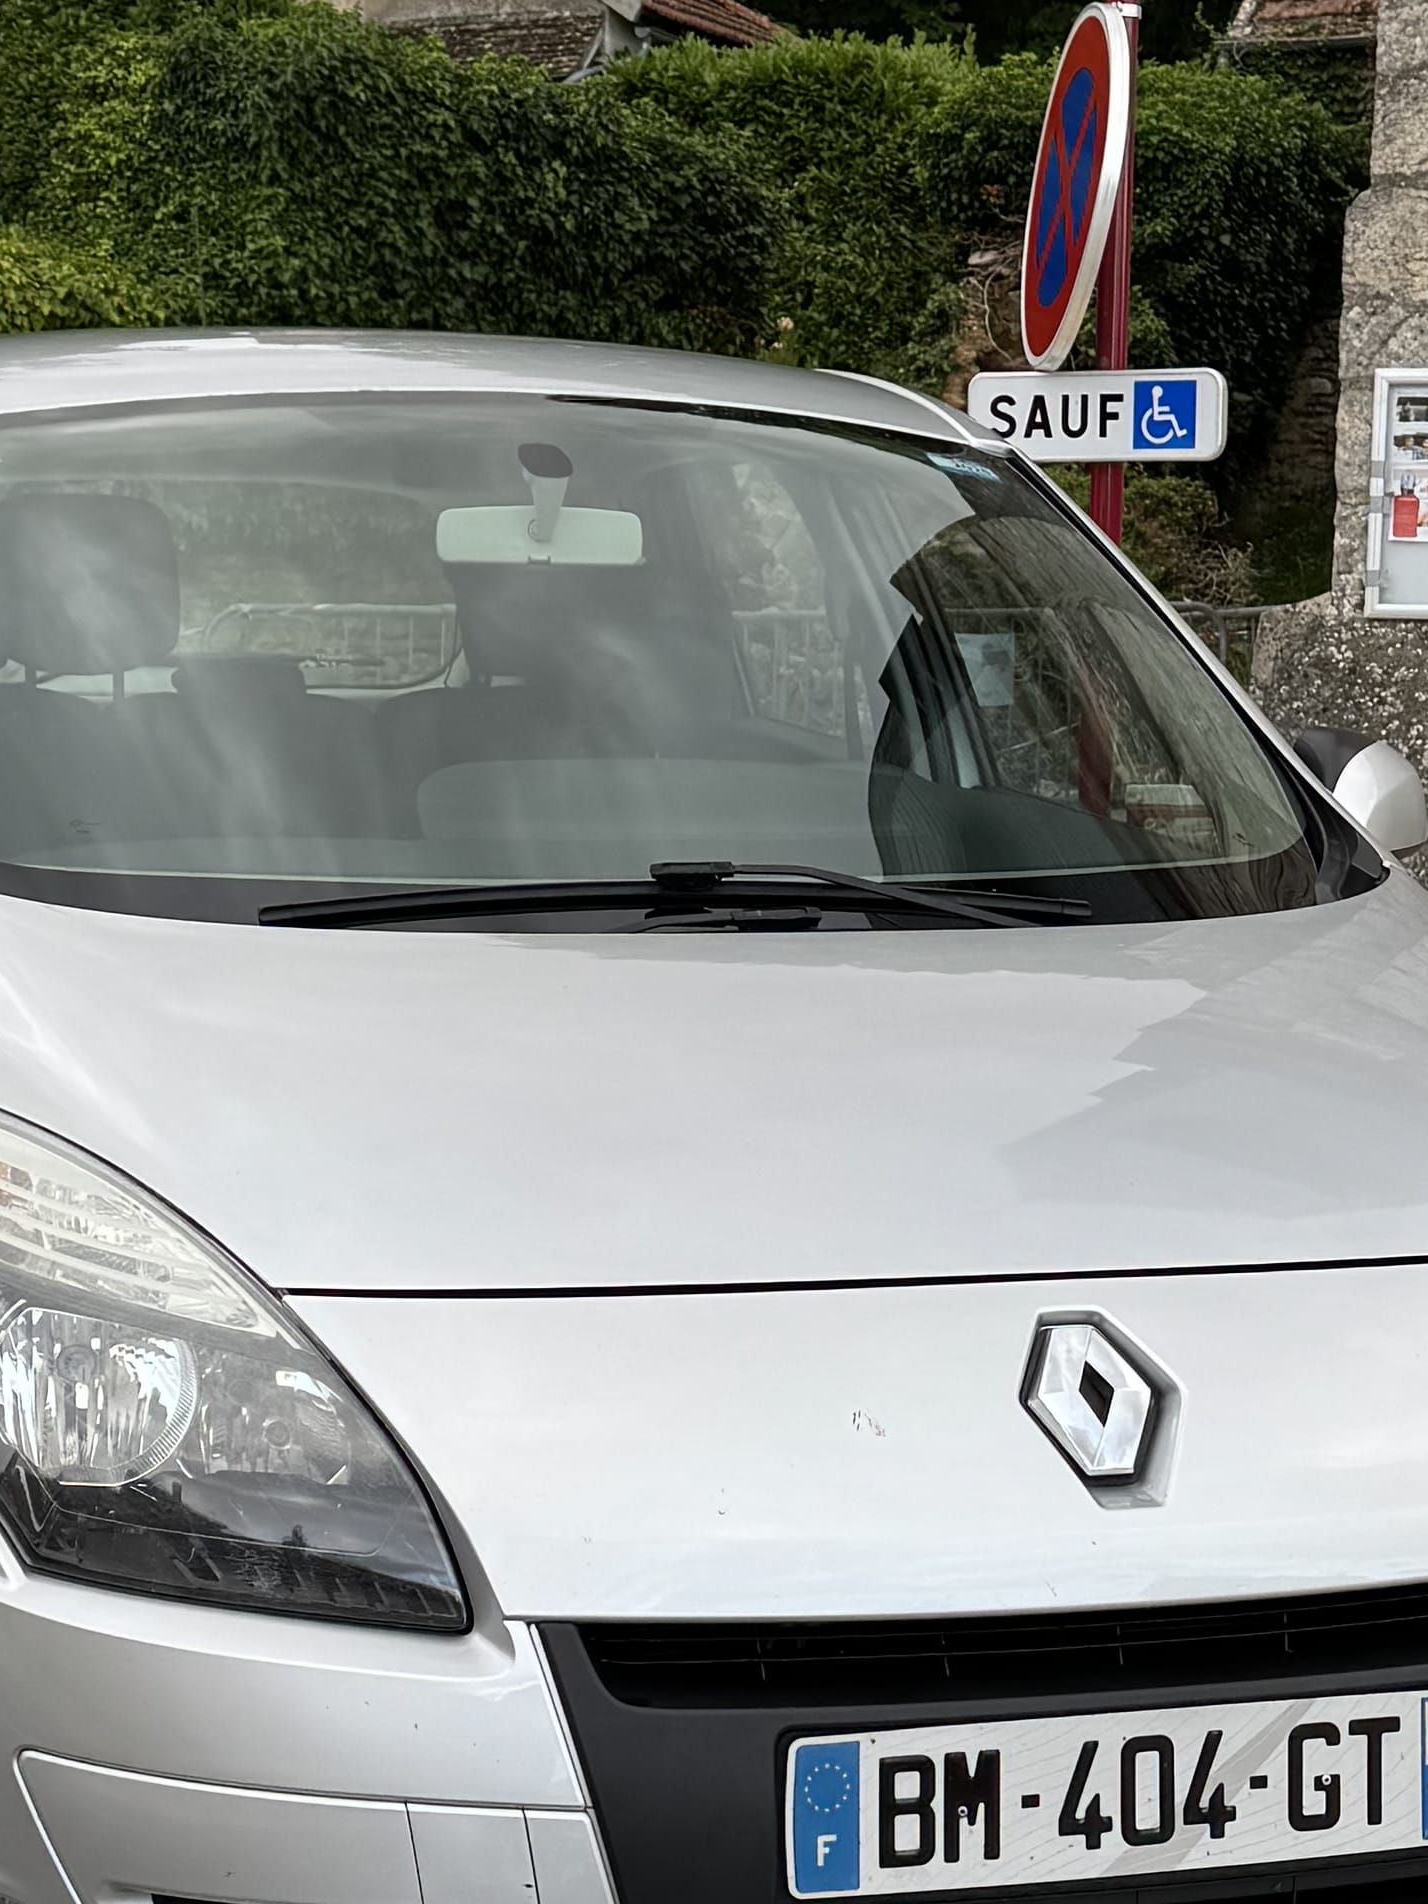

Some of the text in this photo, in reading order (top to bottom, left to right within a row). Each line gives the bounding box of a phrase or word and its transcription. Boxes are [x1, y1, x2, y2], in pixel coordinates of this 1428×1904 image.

[989, 393, 1124, 438] SAUF
[878, 1715, 1402, 1869] BM-404-GT
[817, 1834, 837, 1867] F
